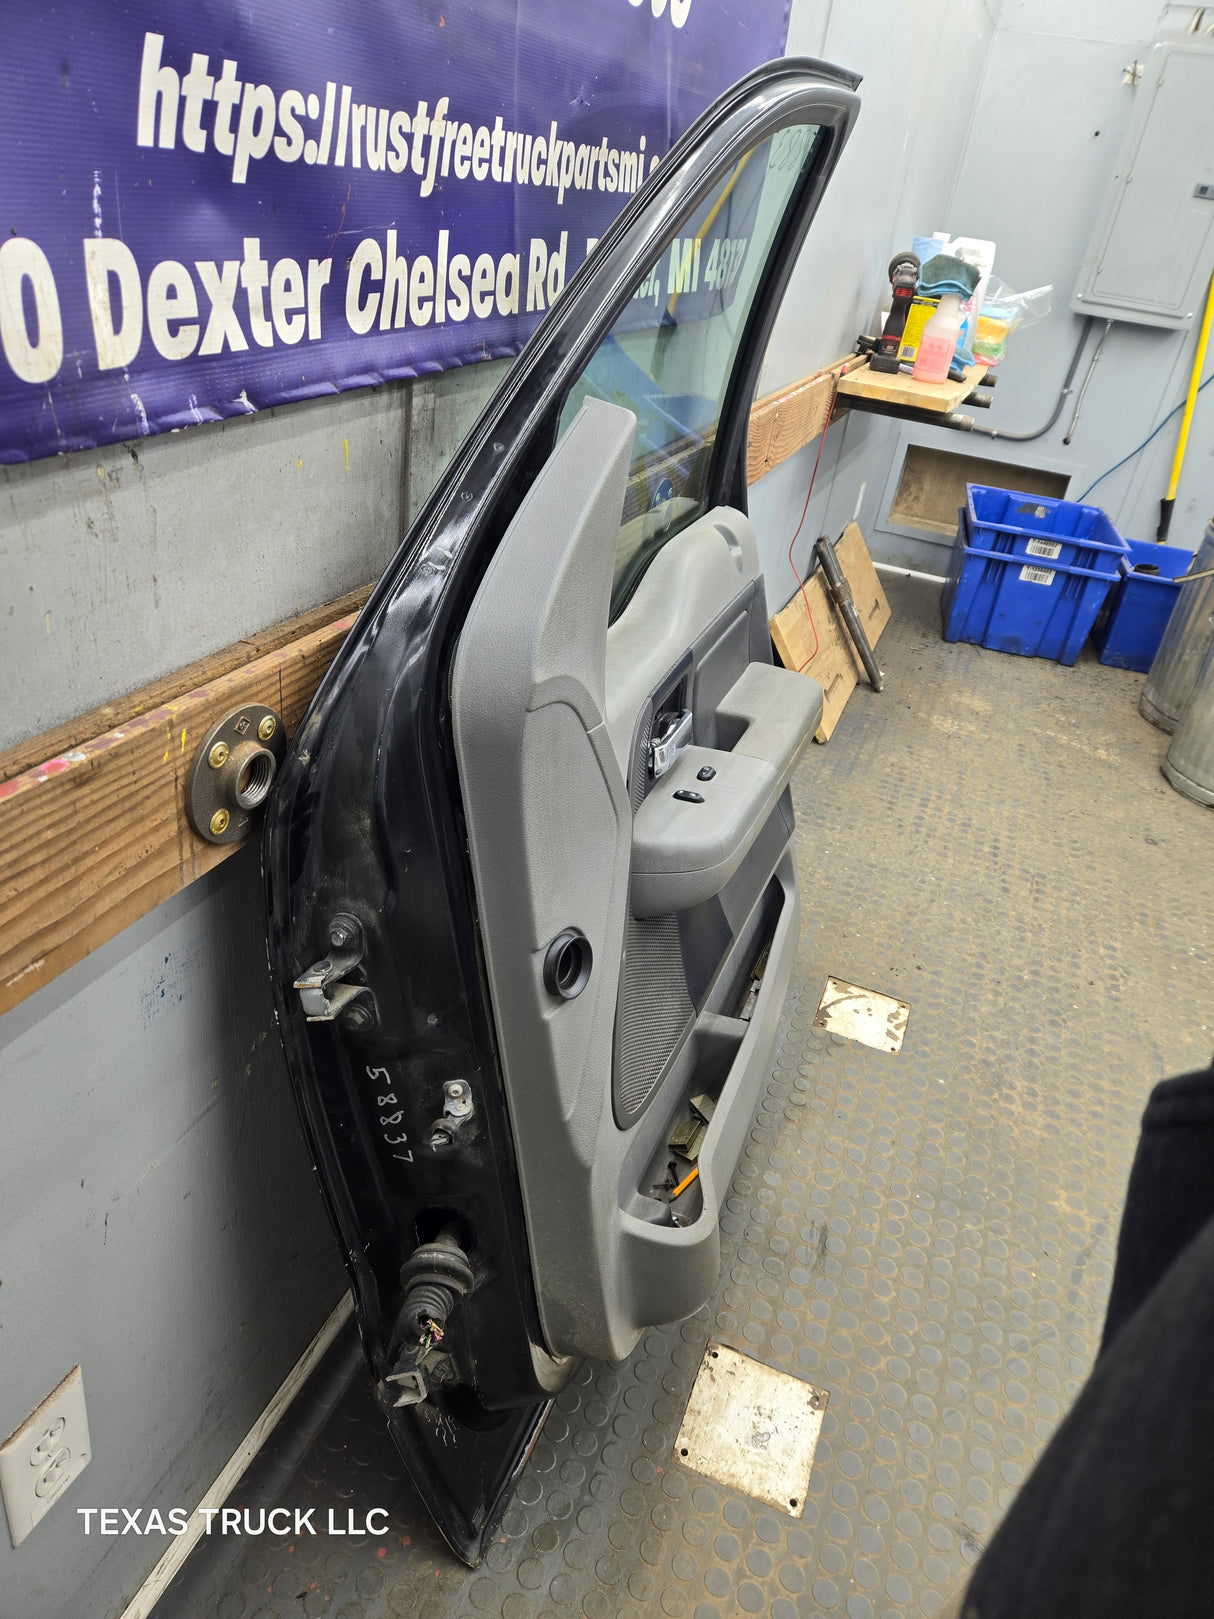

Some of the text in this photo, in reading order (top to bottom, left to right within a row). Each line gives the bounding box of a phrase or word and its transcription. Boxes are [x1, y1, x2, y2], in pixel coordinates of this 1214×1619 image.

[137, 32, 660, 204] https://rustfreetruckpartsmi
[83, 237, 332, 370] Dexter
[345, 229, 520, 335] Chelsea
[667, 238, 702, 294] MI
[366, 1065, 414, 1163] 58837
